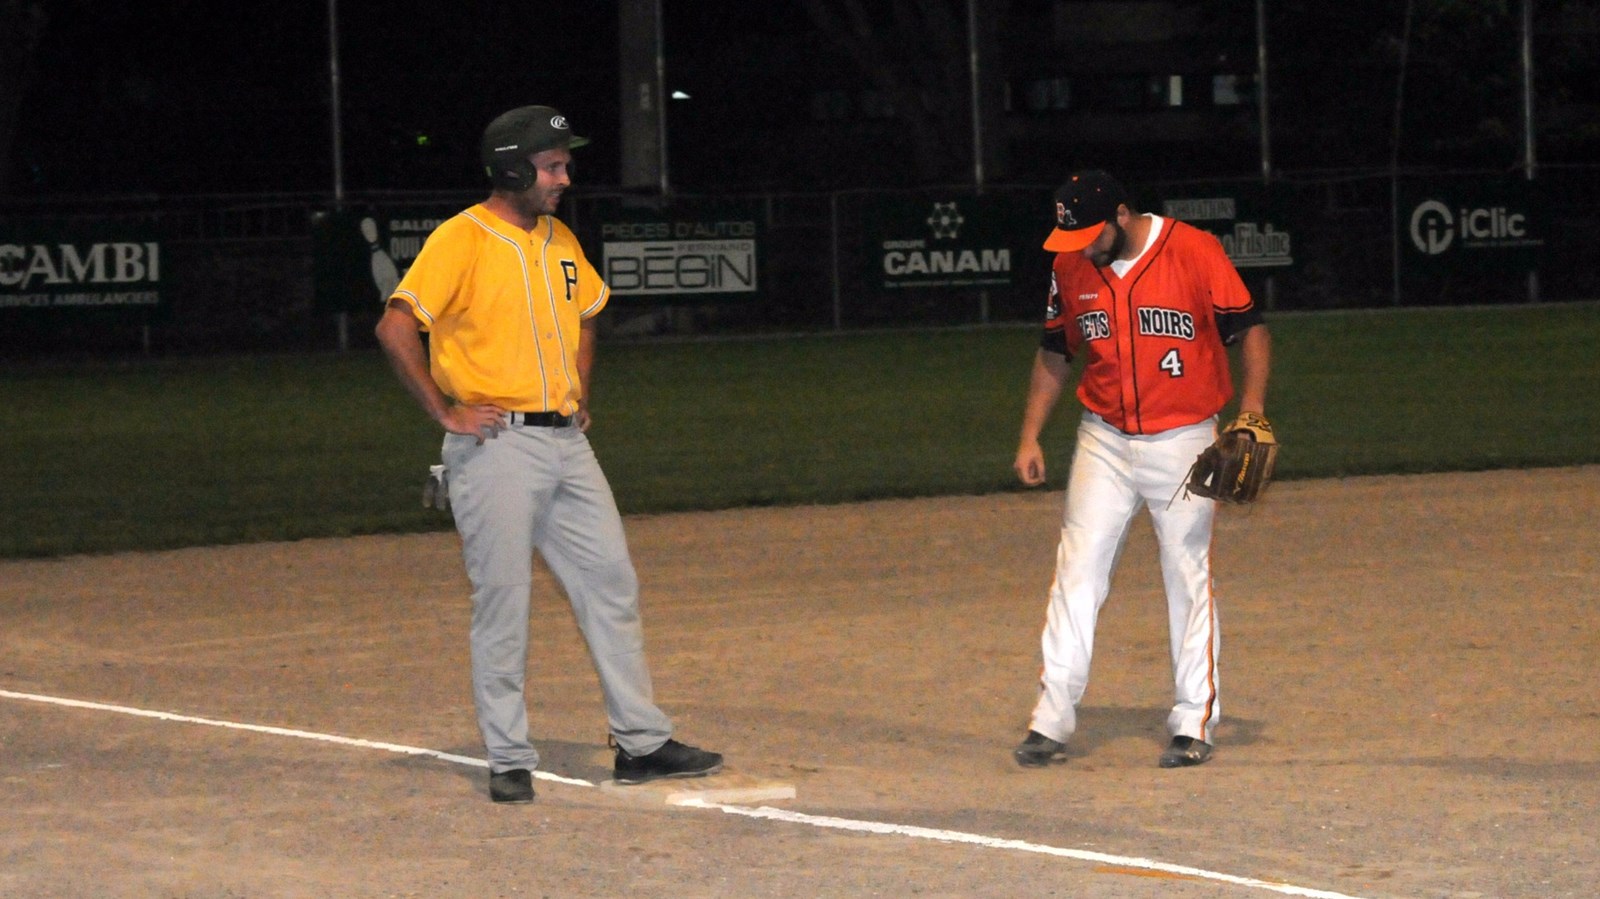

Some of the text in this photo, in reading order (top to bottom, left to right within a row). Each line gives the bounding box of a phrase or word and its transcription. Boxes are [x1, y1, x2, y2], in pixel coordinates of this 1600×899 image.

[389, 218, 444, 231] SALO
[1460, 207, 1527, 239] iClic
[0, 242, 160, 290] CAMBI
[883, 248, 1011, 275] CANAM
[560, 259, 578, 303] P
[1137, 307, 1195, 341] NOIRS
[1160, 348, 1184, 378] 4
